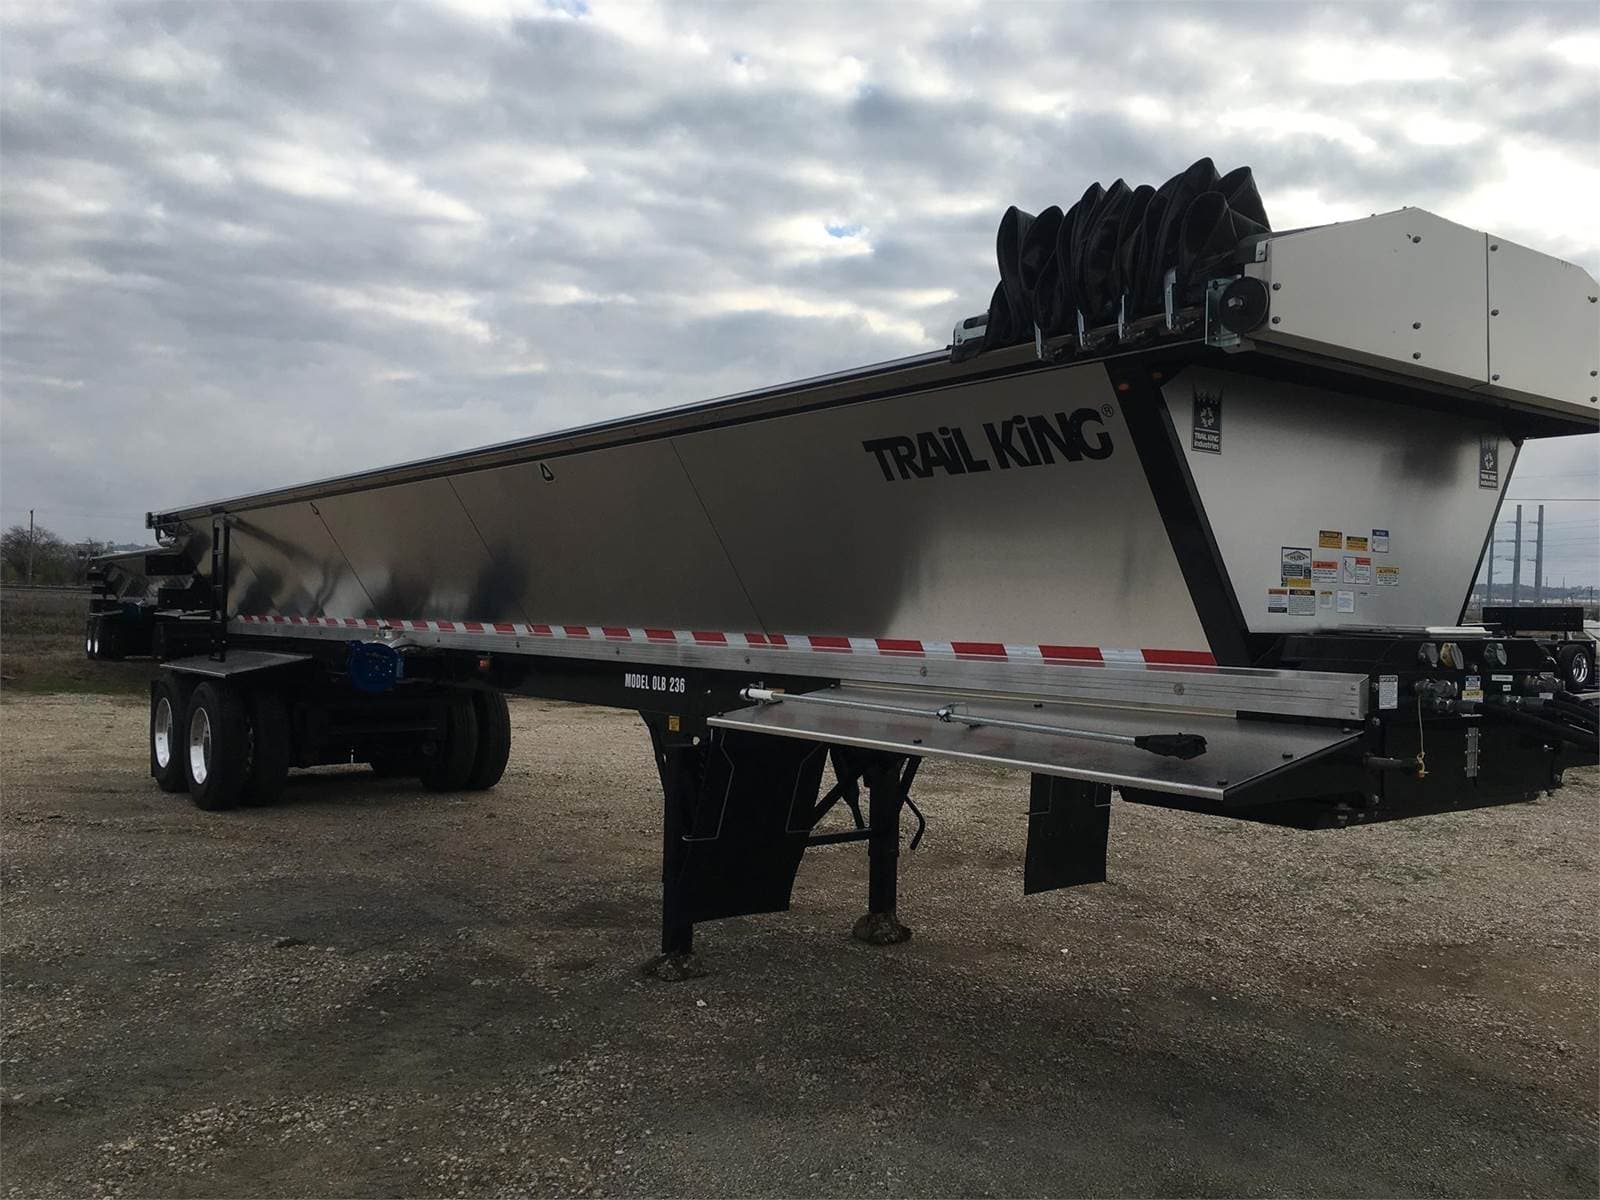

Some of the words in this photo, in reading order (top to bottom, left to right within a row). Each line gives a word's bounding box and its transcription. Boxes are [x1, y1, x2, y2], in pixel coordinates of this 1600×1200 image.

[624, 673, 649, 689] MODEL
[652, 675, 666, 691] OLB
[669, 677, 685, 693] 236
